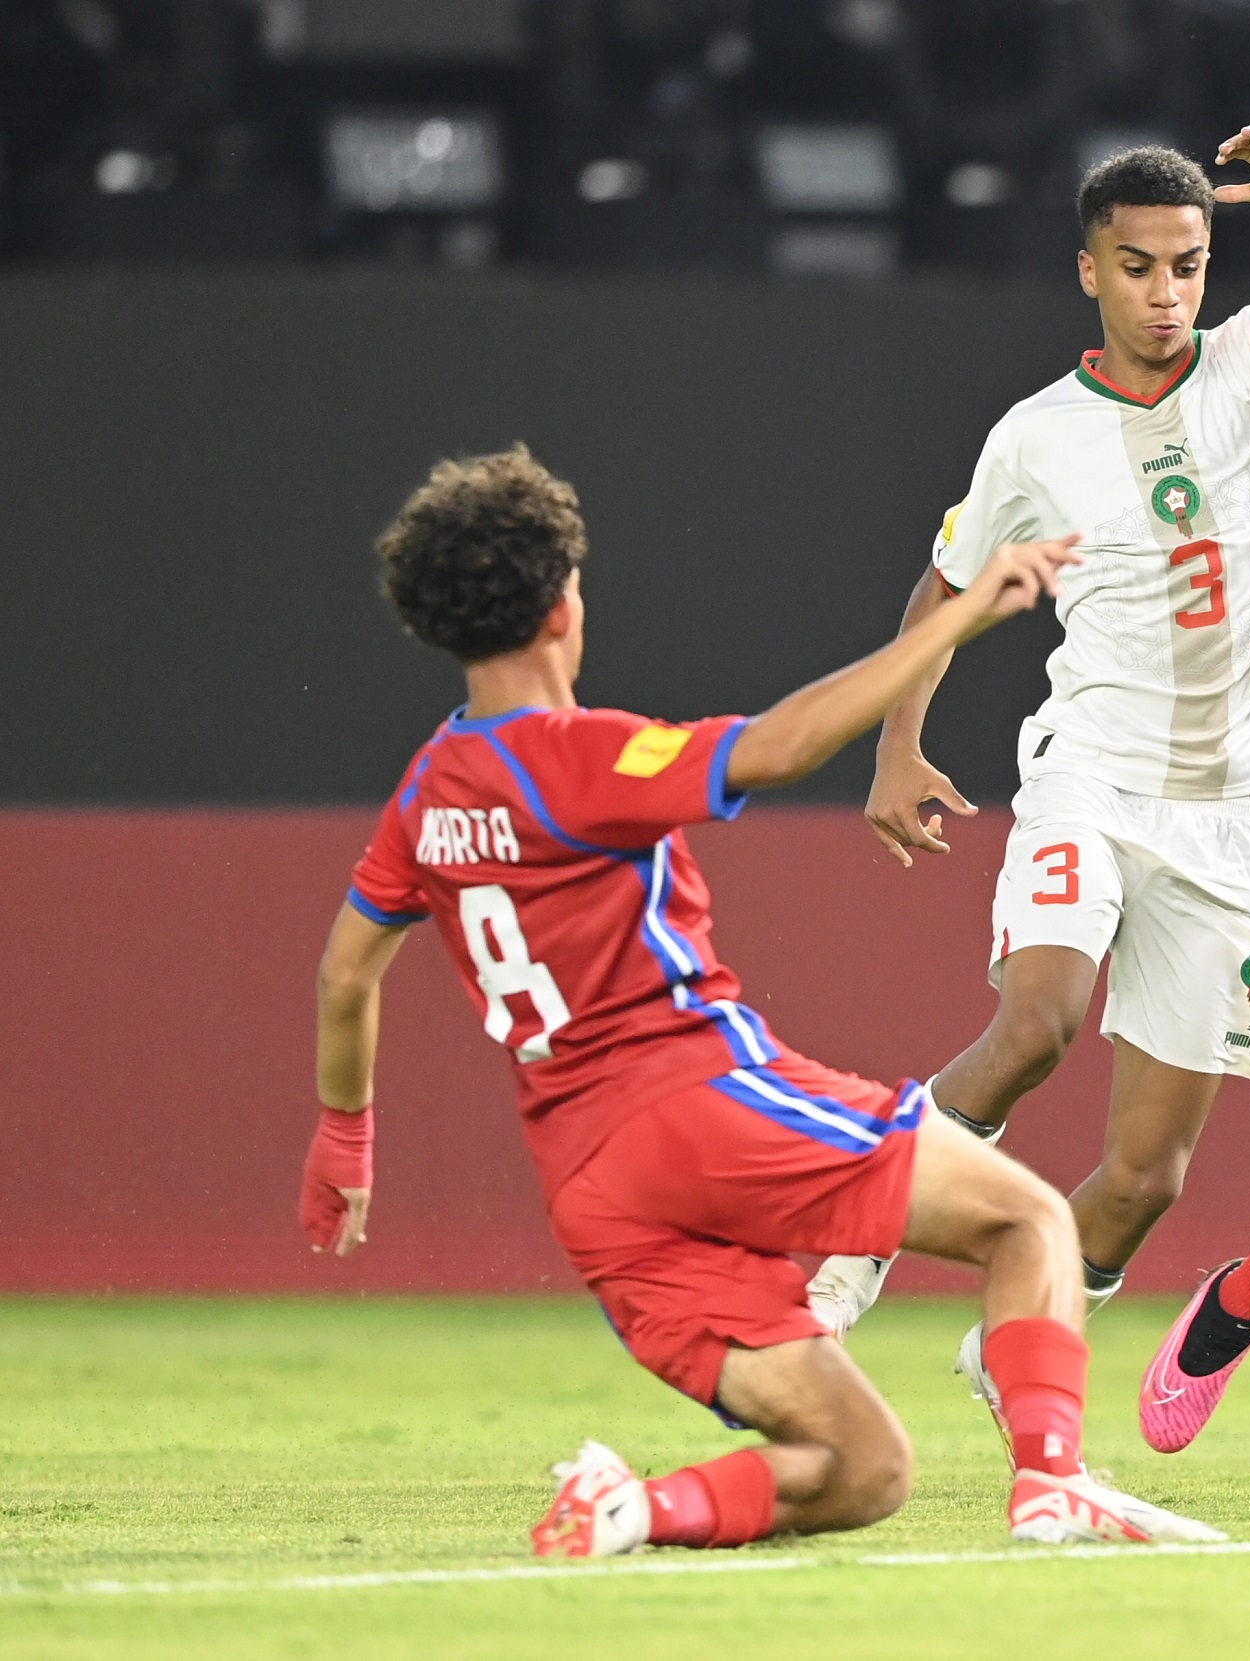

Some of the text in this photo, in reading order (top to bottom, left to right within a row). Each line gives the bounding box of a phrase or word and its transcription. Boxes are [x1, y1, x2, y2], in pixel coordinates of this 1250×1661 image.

[1142, 453, 1183, 474] PUMA
[1169, 539, 1226, 629] 3
[1031, 841, 1079, 905] 3
[460, 885, 571, 1064] 8
